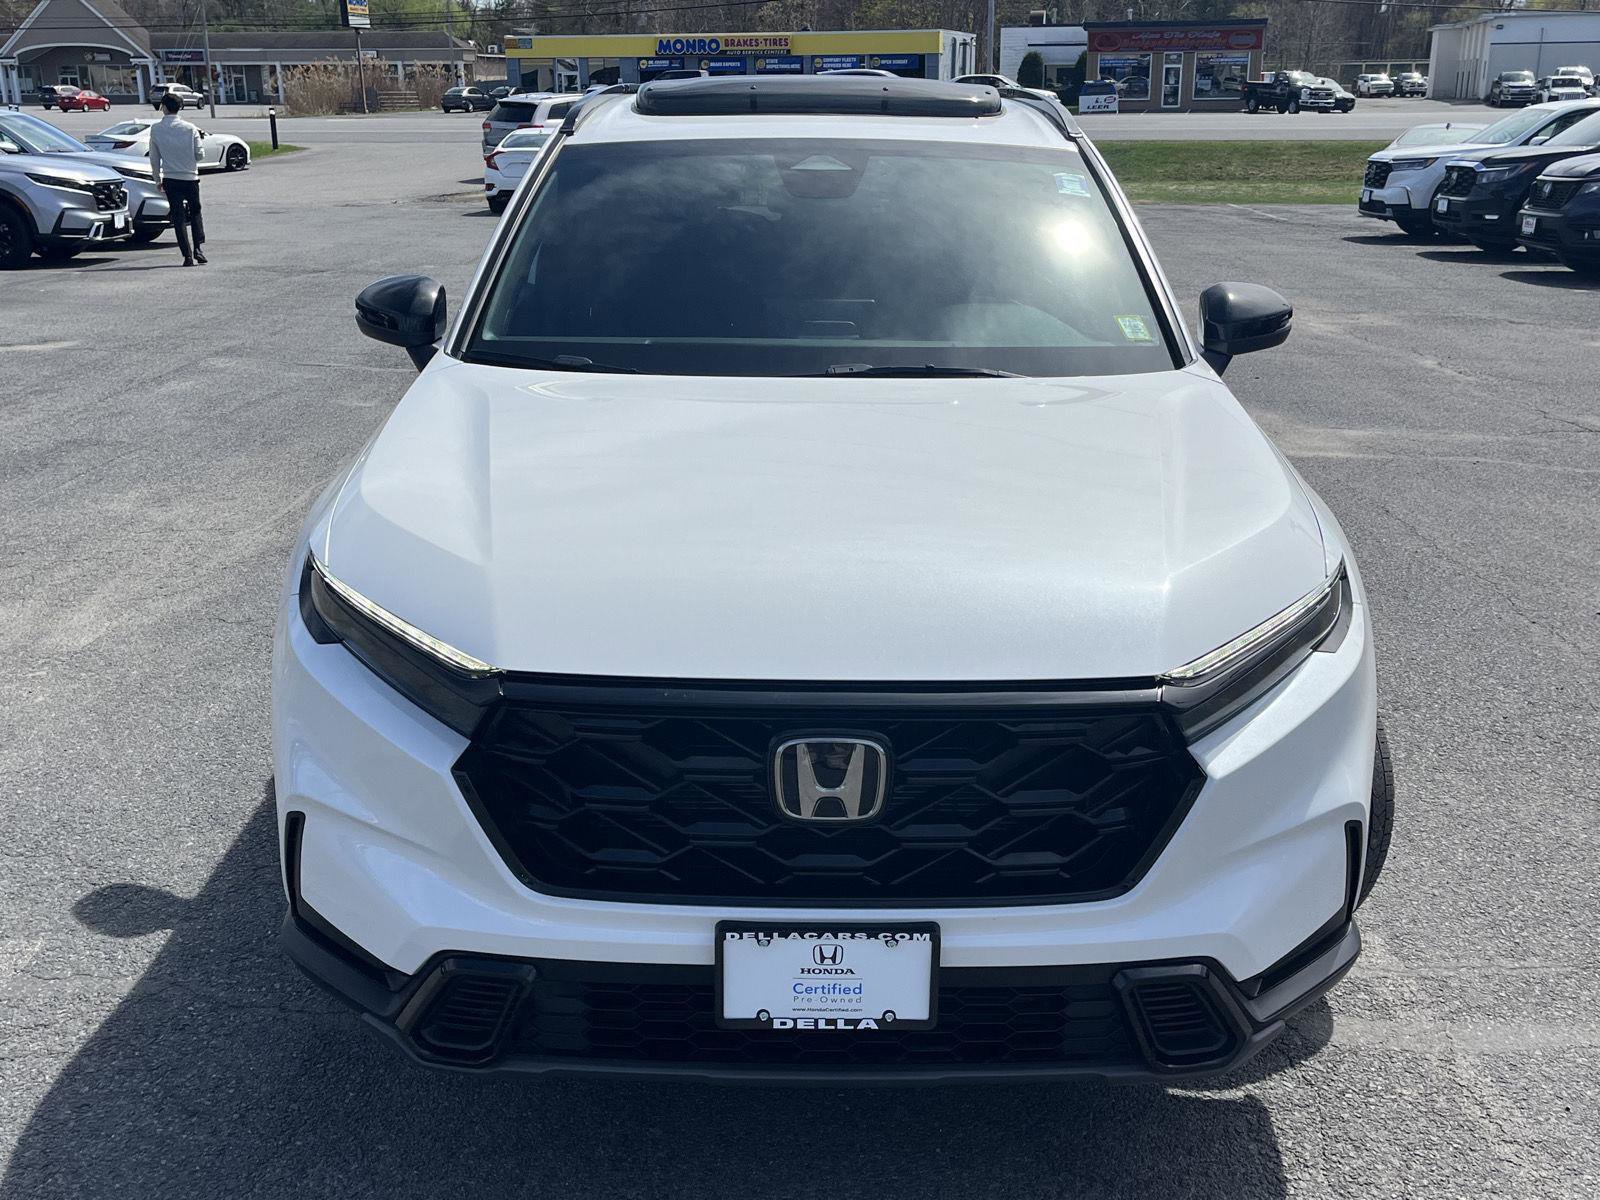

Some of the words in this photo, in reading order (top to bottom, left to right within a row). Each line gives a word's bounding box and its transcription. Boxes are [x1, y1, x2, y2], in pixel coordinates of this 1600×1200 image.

[657, 37, 721, 54] MONRO
[725, 932, 931, 942] DELLACARS.COM
[800, 967, 856, 975] HONDA
[792, 982, 863, 995] Certified
[772, 1018, 879, 1030] DELLA
